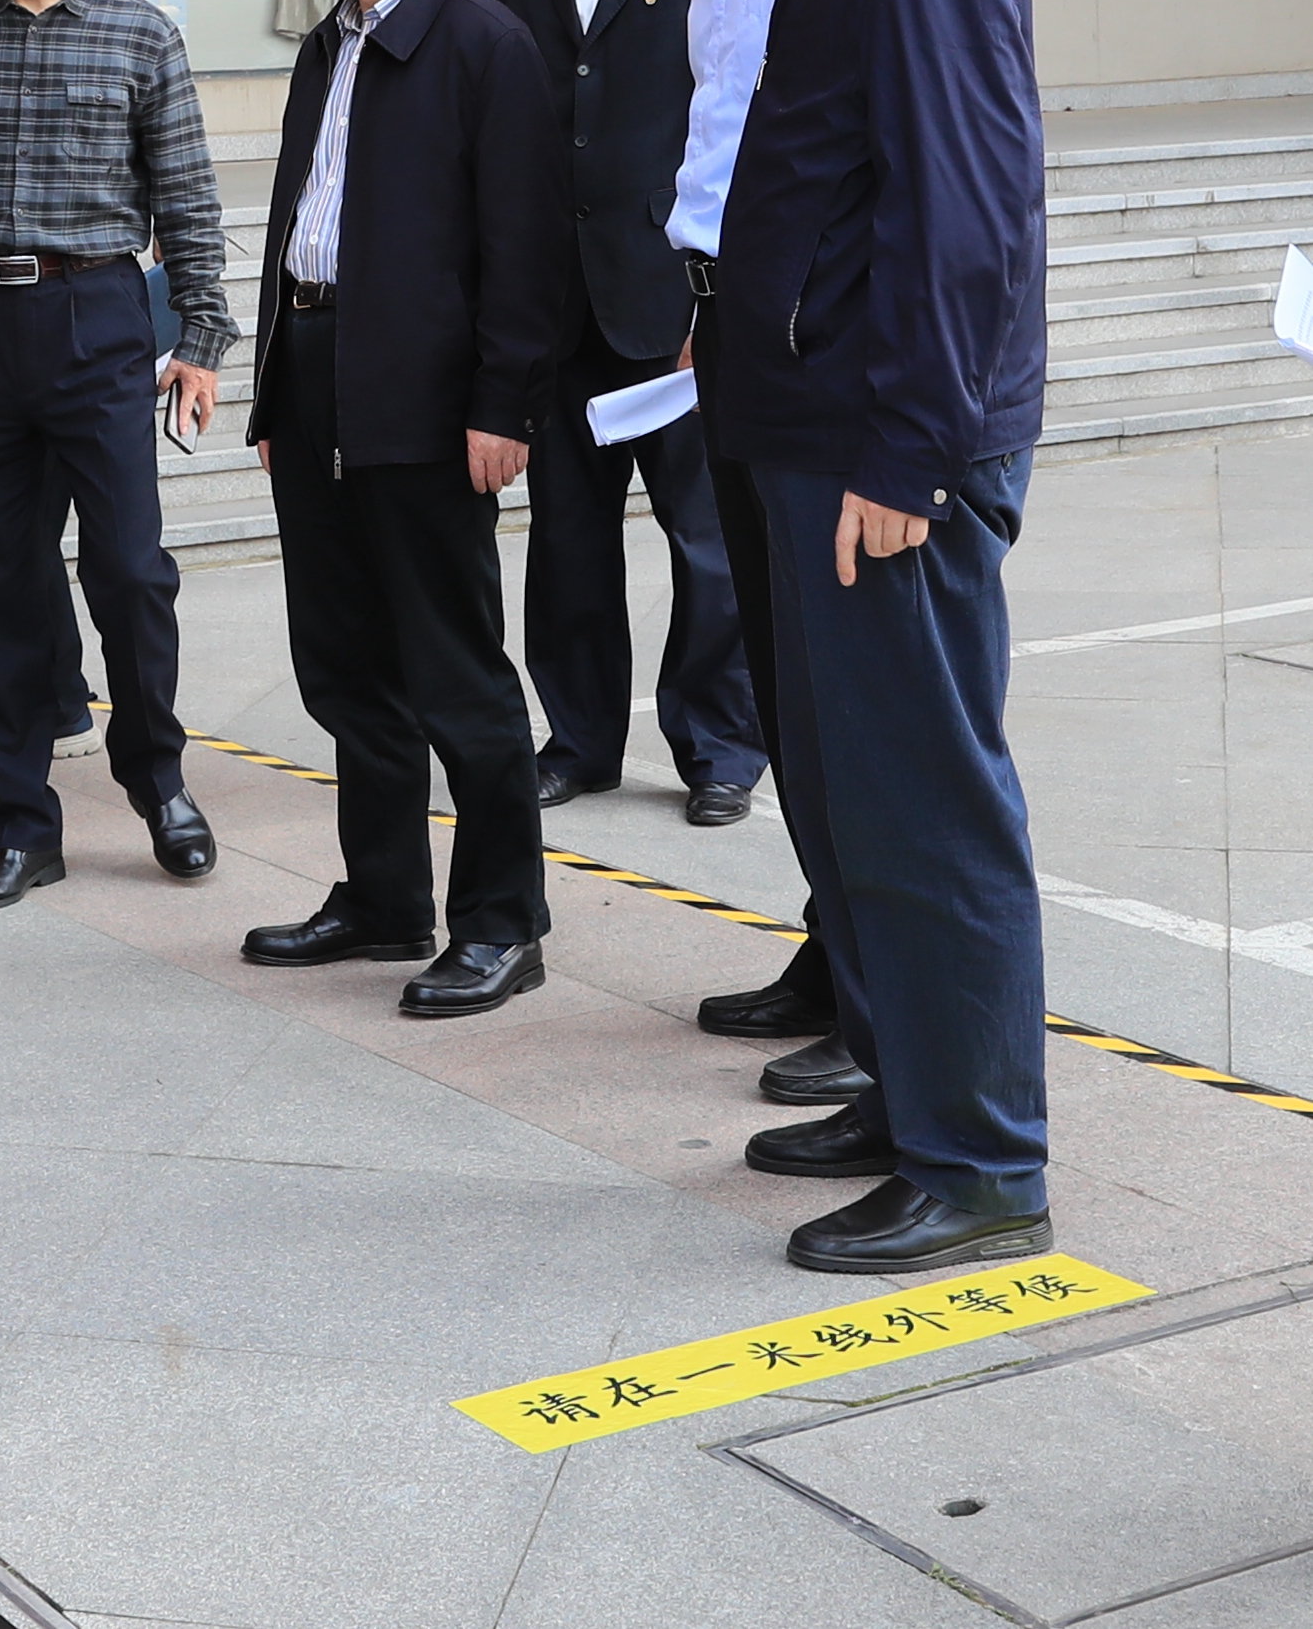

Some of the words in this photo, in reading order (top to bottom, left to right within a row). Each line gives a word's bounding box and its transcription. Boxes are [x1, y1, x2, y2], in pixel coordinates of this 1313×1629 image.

[521, 1273, 1100, 1427] 请在一米线外等候
